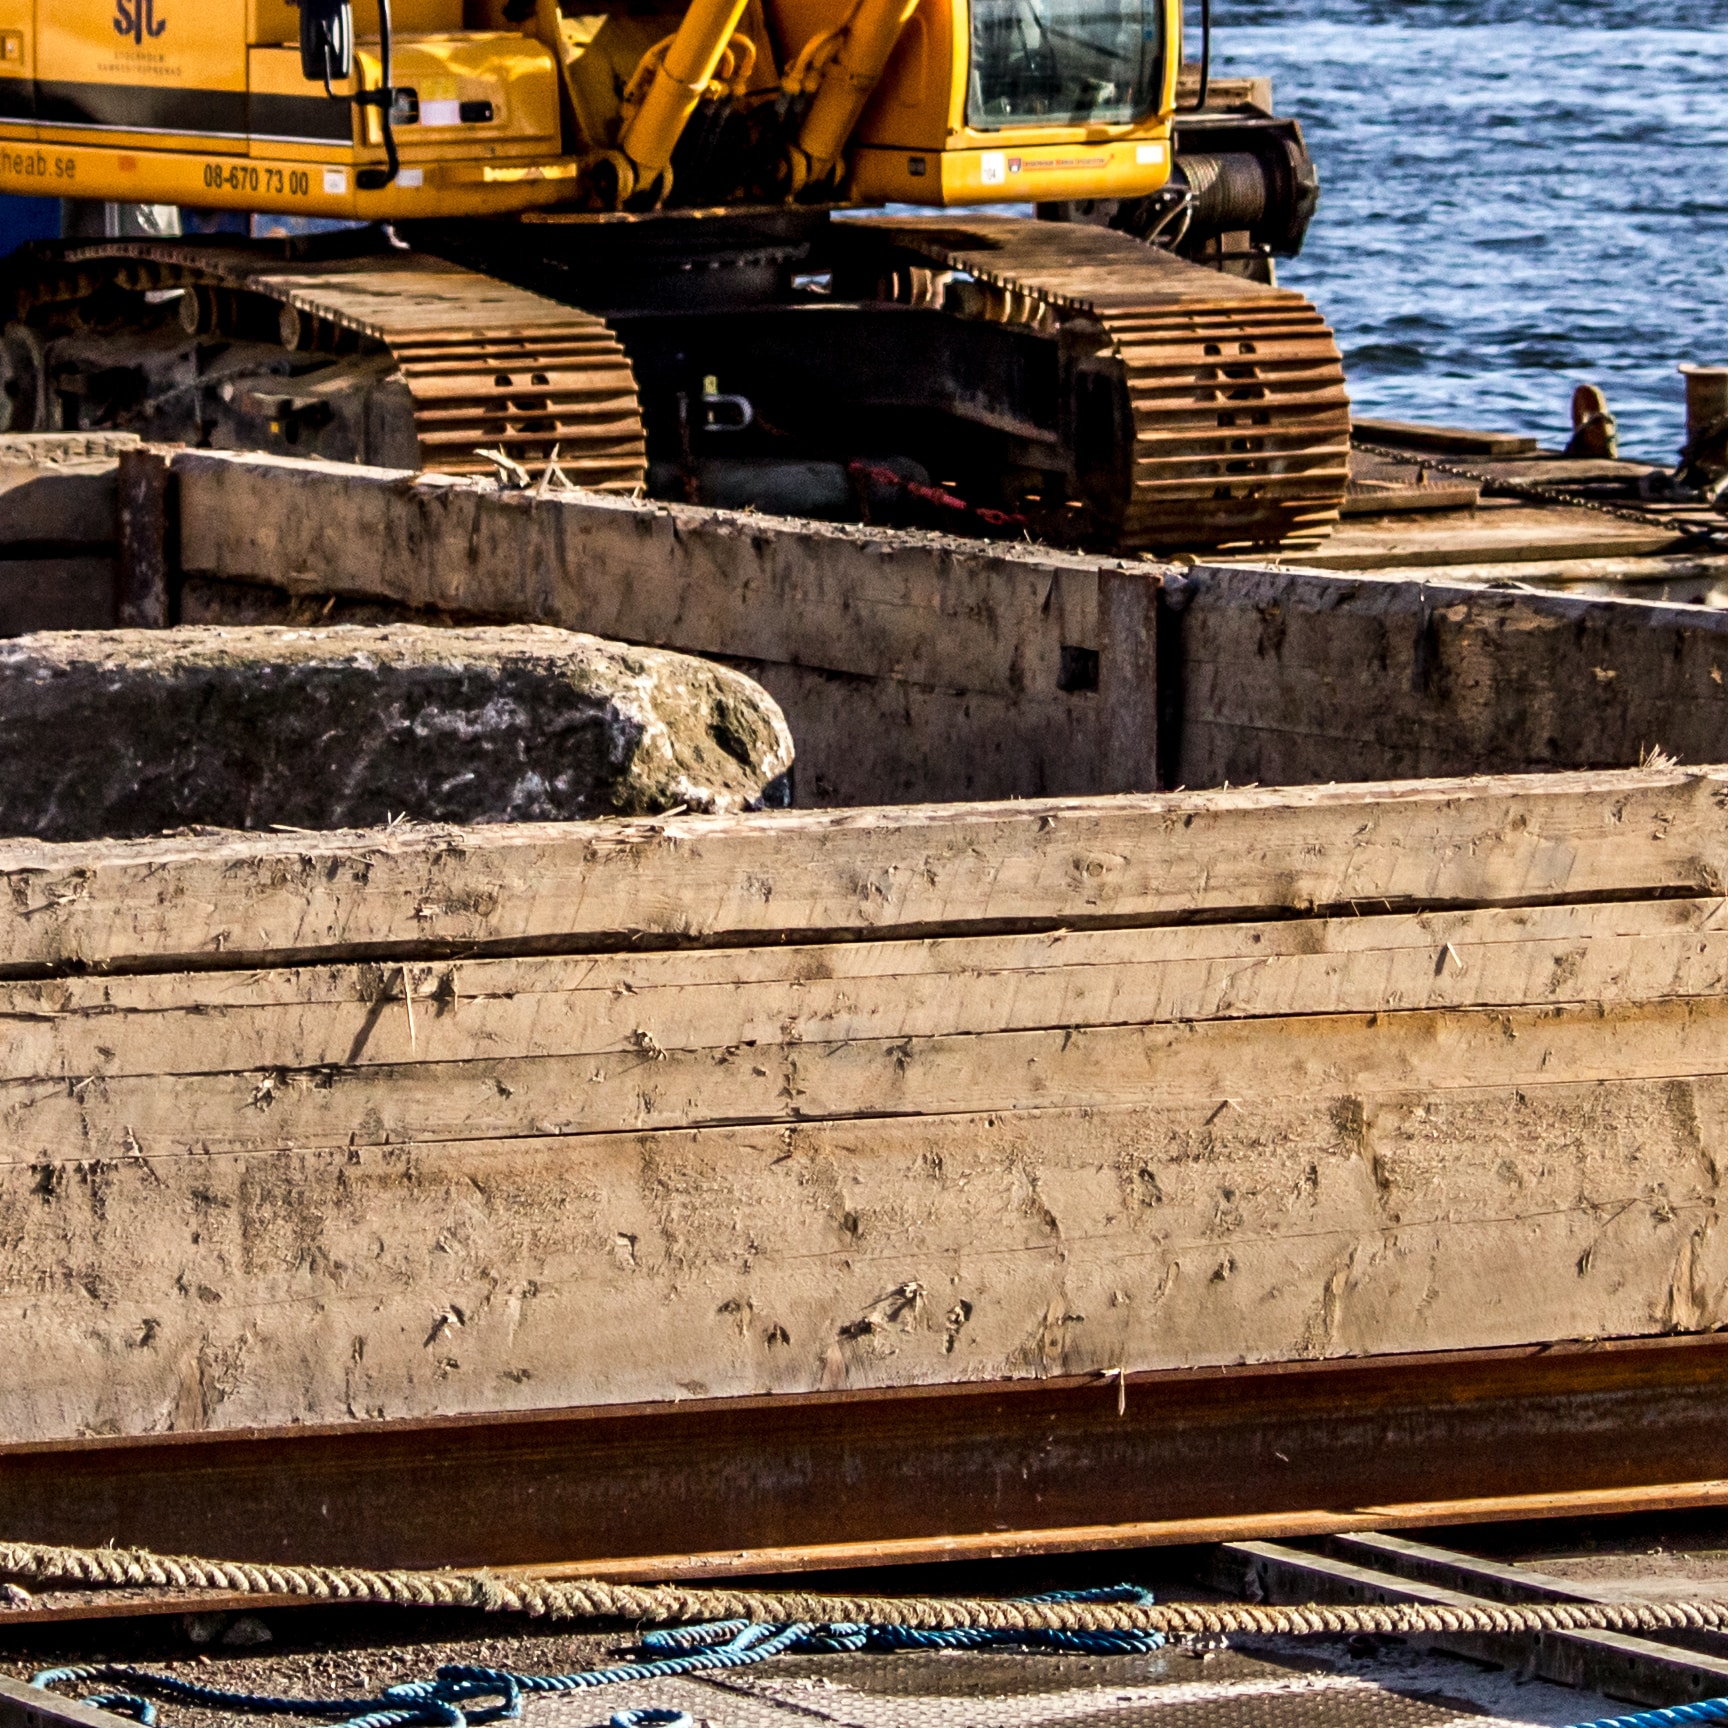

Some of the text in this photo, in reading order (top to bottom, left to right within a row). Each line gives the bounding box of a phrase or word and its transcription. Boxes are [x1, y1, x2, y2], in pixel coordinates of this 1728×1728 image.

[203, 163, 259, 192] 08-670
[264, 168, 284, 194] 73
[289, 170, 309, 196] 00
